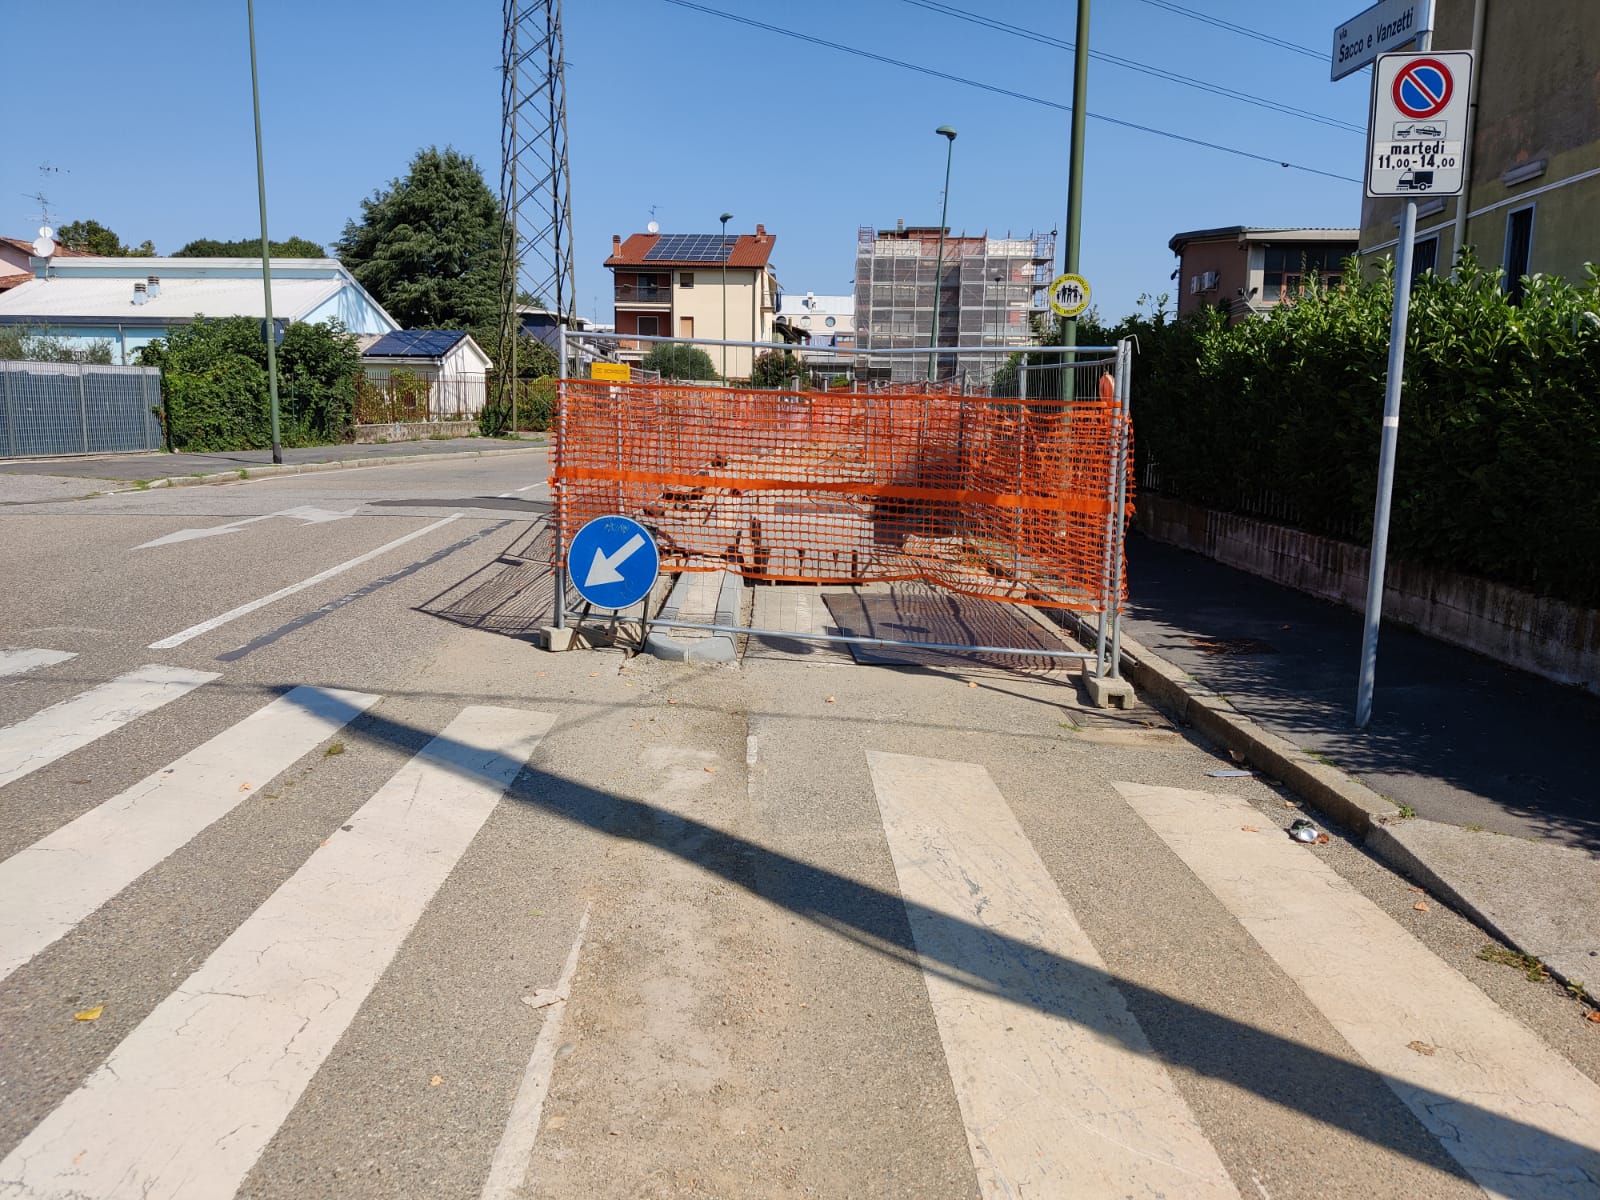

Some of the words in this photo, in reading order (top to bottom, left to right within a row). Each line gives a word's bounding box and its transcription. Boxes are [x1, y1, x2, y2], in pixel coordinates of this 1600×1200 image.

[1339, 28, 1347, 40] via
[1339, 38, 1364, 63] Sacco
[1367, 34, 1373, 48] e
[1376, 8, 1414, 43] Vanzetti
